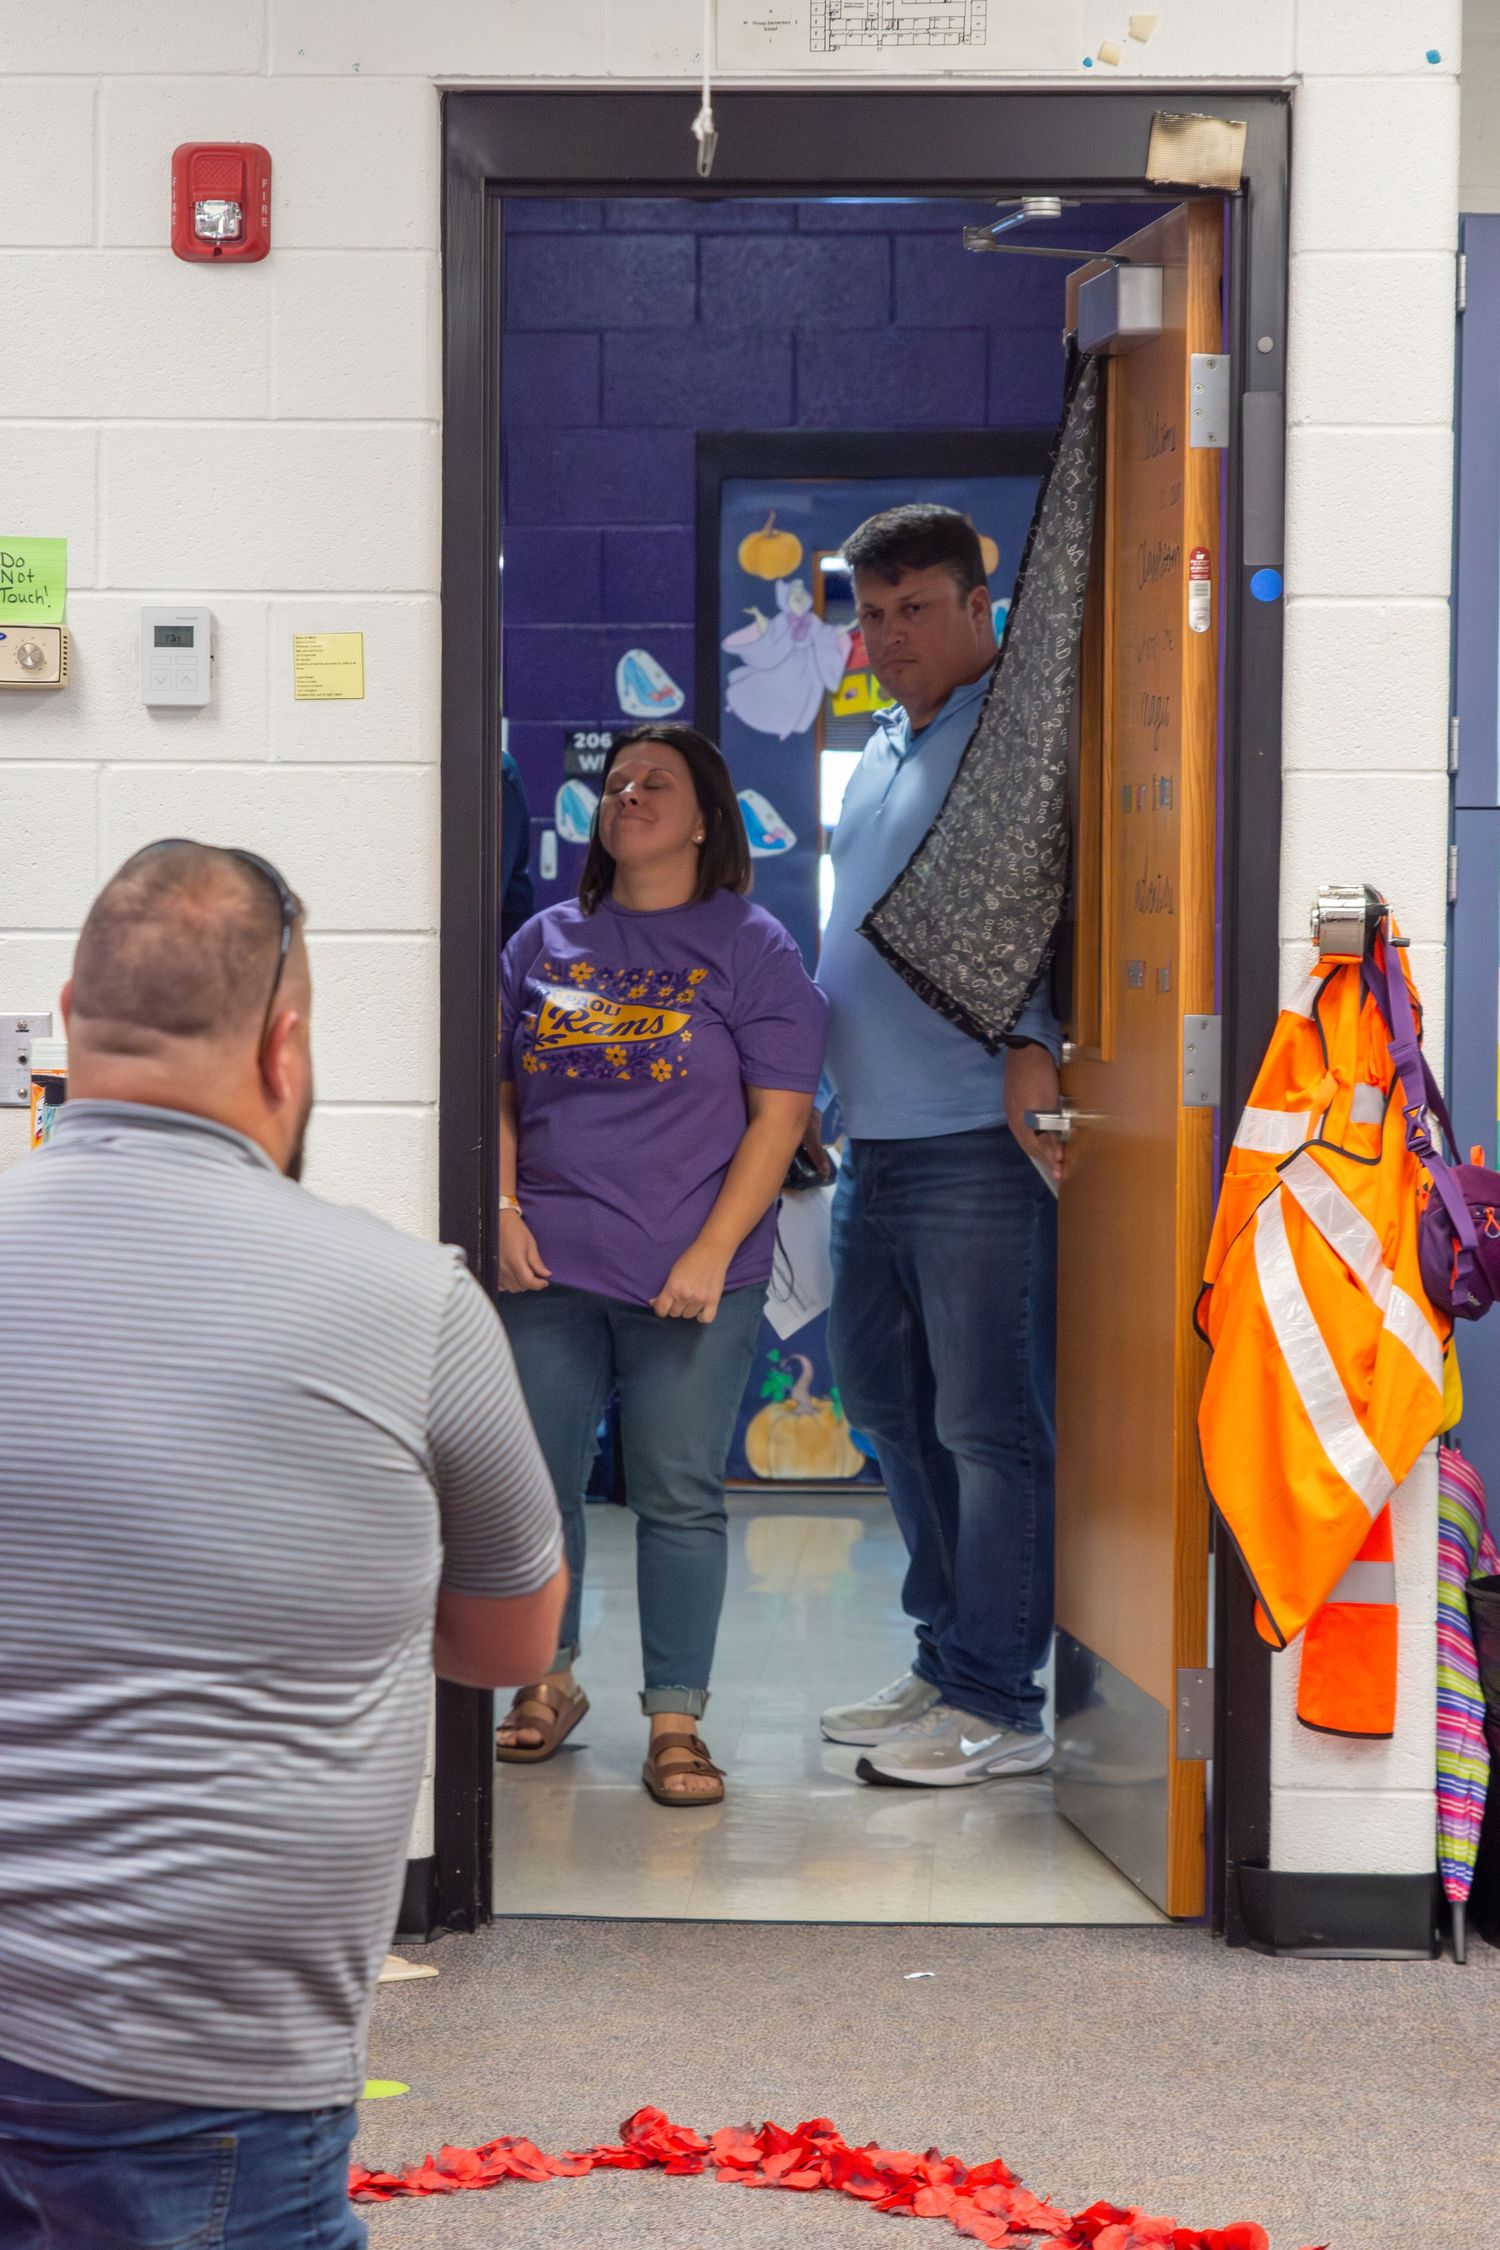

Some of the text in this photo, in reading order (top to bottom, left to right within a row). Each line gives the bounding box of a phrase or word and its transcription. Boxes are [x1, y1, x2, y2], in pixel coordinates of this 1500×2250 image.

[1, 552, 25, 568] Do
[1, 568, 35, 584] Not
[0, 585, 51, 608] Touch!
[573, 732, 613, 749] 206
[547, 1006, 665, 1038] Rams
